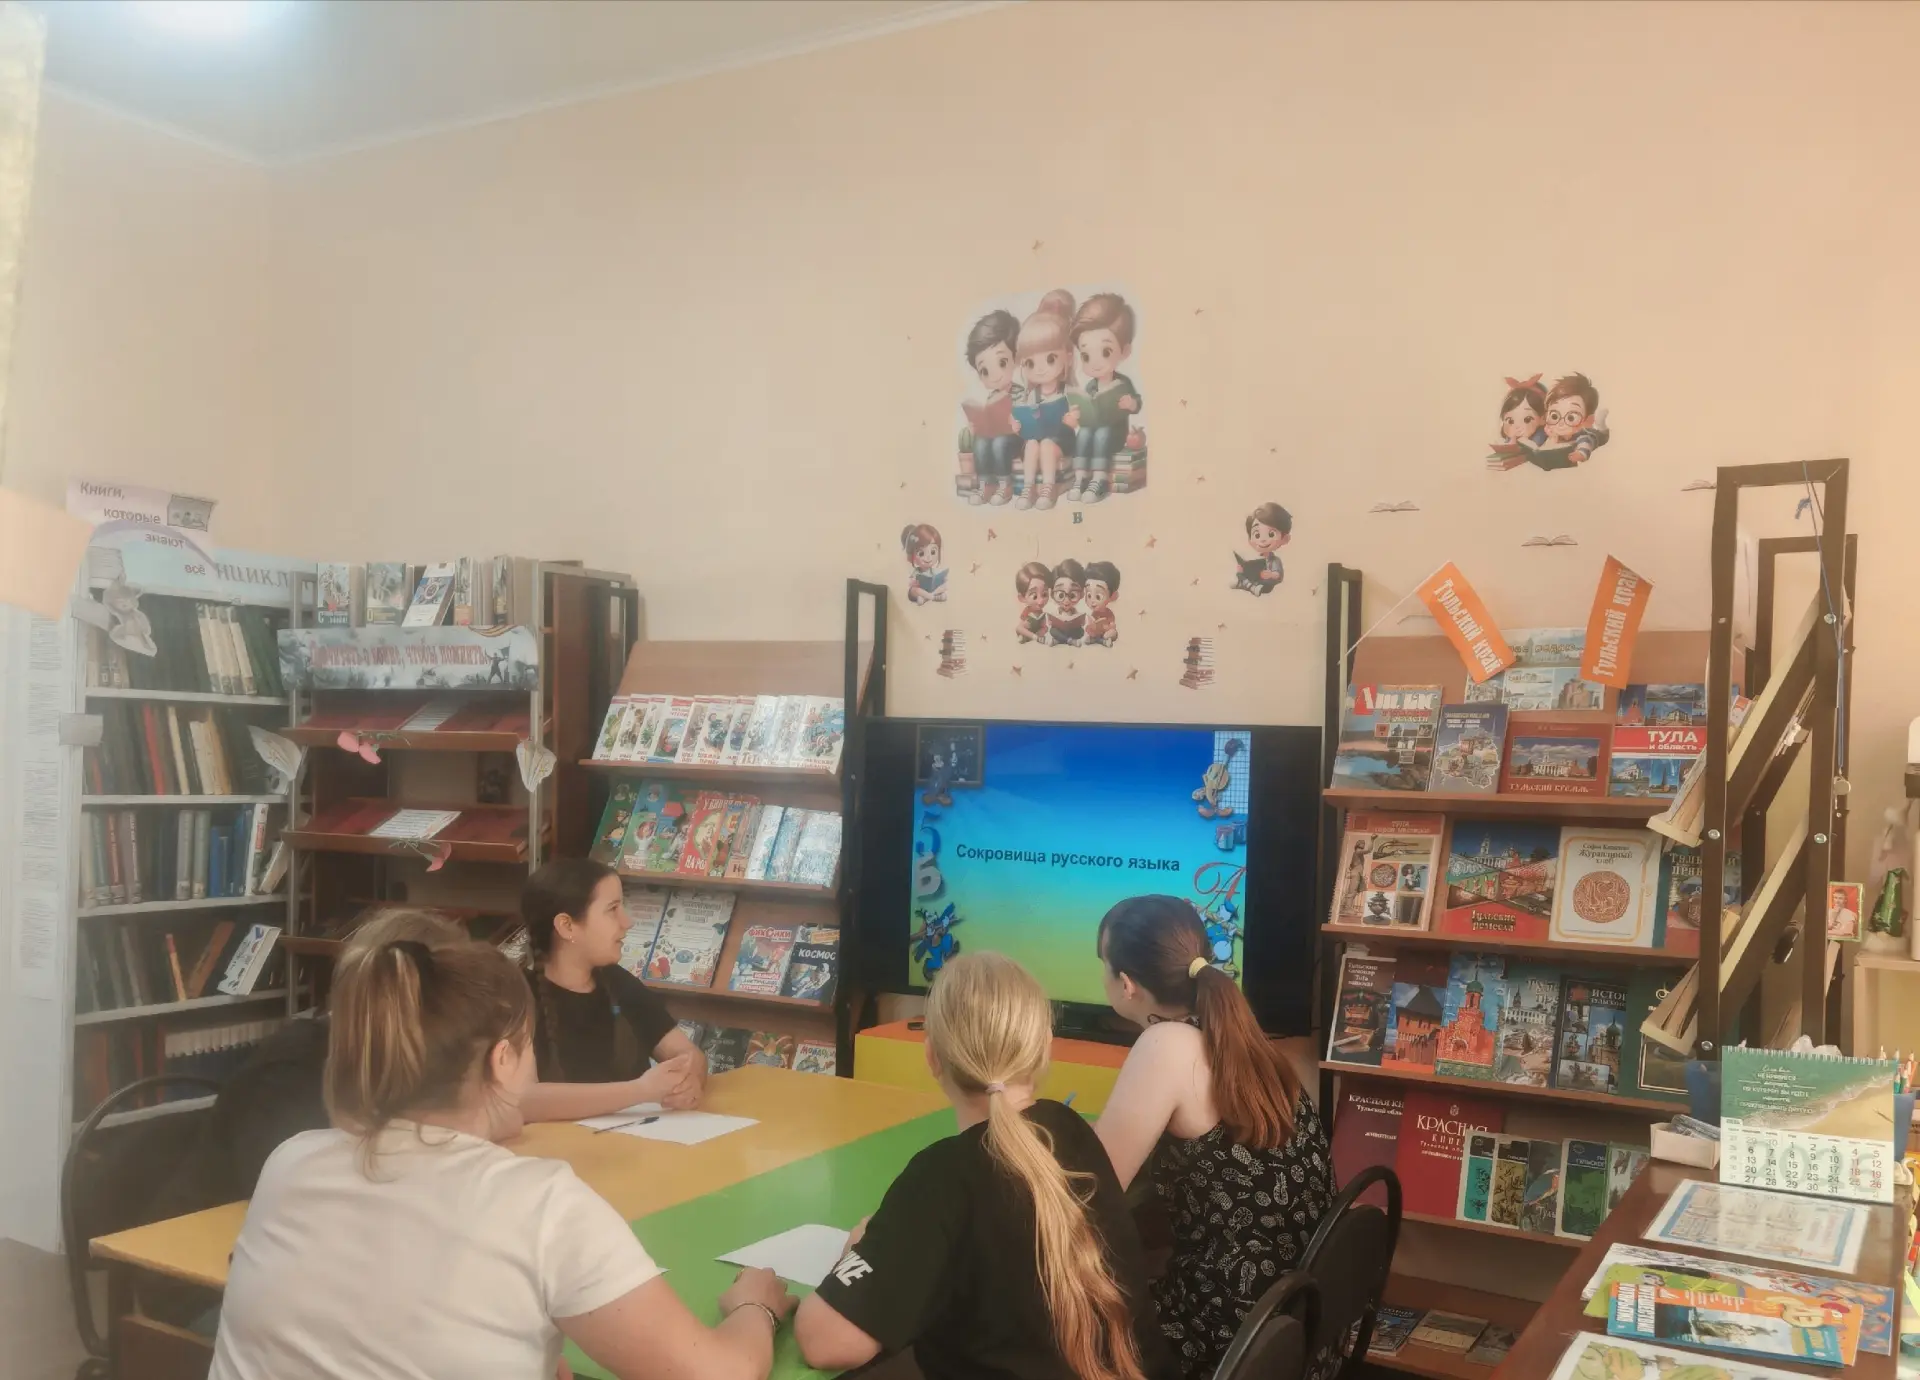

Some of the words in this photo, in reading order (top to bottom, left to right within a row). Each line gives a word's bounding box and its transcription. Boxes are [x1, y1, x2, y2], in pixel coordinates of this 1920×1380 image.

[80, 481, 125, 499] Книги,
[104, 507, 161, 524] которые
[145, 533, 185, 549] знают
[184, 563, 206, 576] всё
[1433, 578, 1486, 642] Тульский
[1472, 632, 1505, 674] край
[1592, 608, 1627, 678] Тульский
[1613, 567, 1640, 605] край
[1647, 730, 1698, 743] ТУЛА
[956, 843, 1046, 864] Сокровища
[1051, 851, 1123, 868] русского
[1128, 857, 1180, 872] языка
[798, 948, 836, 960] КОСМОС
[1349, 1094, 1391, 1107] КРАСНАЯ
[1748, 1146, 1754, 1154] 6
[1769, 1148, 1775, 1157] 7
[1789, 1151, 1795, 1159] 8
[1810, 1152, 1816, 1161] 9
[1829, 1155, 1839, 1164] 10
[1872, 1160, 1882, 1169] 12
[1790, 1141, 1795, 1149] 1
[1810, 1143, 1817, 1151] 2
[1831, 1145, 1838, 1153] 3
[1852, 1148, 1858, 1156] 4
[1873, 1149, 1880, 1158] 5
[1746, 1156, 1757, 1164] 13
[1767, 1158, 1777, 1166] 14
[1788, 1161, 1798, 1169] 15
[1808, 1163, 1818, 1171] 16
[1829, 1165, 1839, 1174] 17
[1850, 1168, 1860, 1176] 18
[1871, 1170, 1882, 1179] 19
[1745, 1165, 1757, 1174] 20
[1766, 1168, 1776, 1176] 21
[1786, 1170, 1798, 1179] 22
[1807, 1172, 1819, 1181] 23
[1828, 1175, 1839, 1184] 24
[1849, 1177, 1860, 1186] 25
[1870, 1180, 1882, 1189] 26
[1745, 1175, 1756, 1184] 27
[1766, 1178, 1777, 1186] 28
[1786, 1180, 1798, 1189] 29
[1807, 1182, 1818, 1191] 30
[1828, 1185, 1838, 1194] 31
